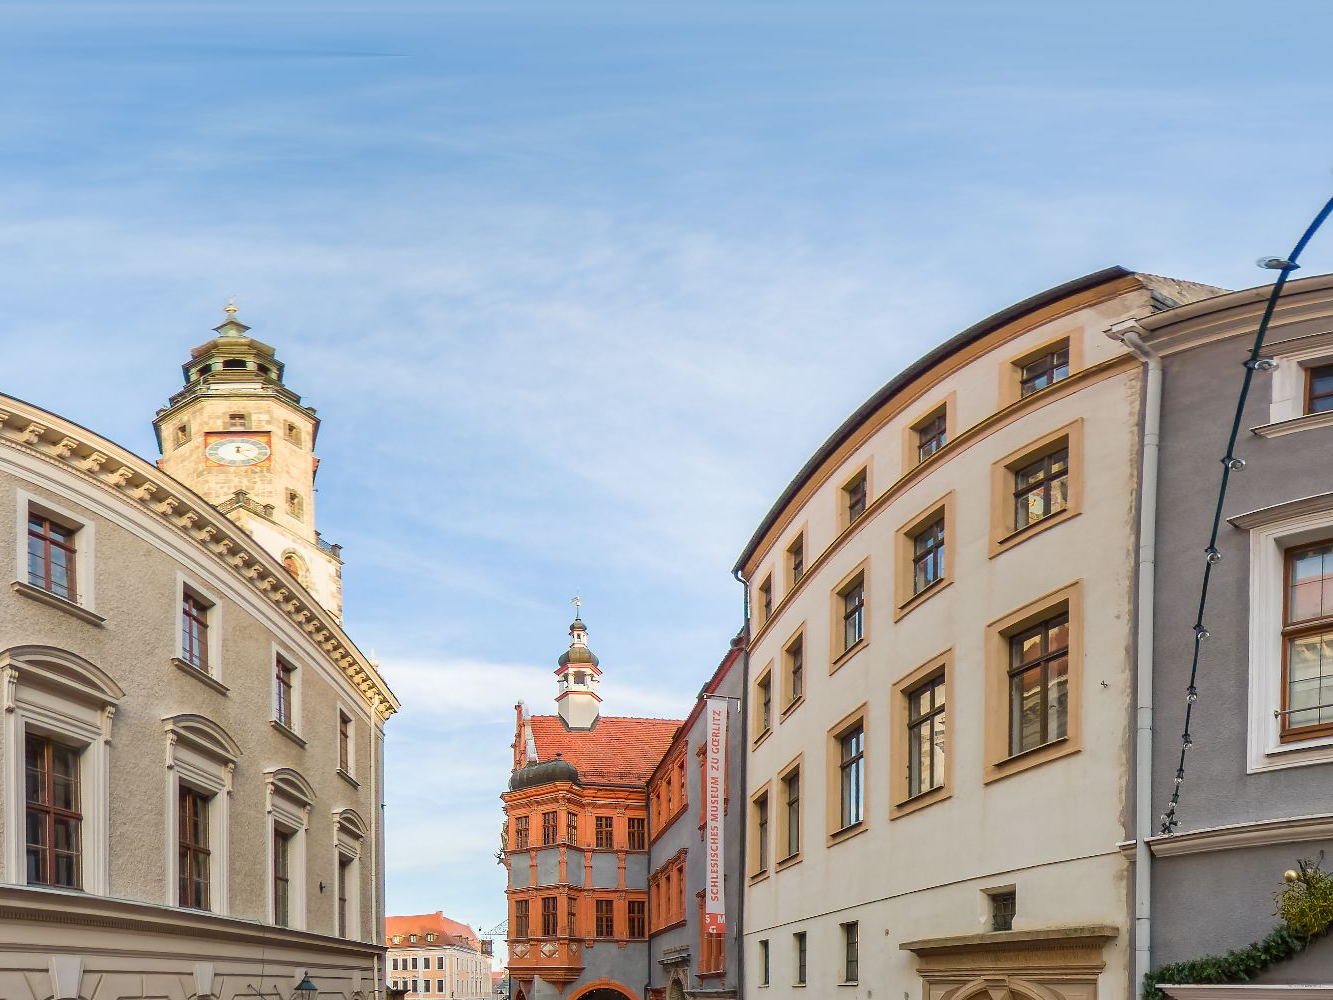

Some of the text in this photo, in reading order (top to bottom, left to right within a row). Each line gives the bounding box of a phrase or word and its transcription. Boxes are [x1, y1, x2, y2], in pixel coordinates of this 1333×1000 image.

[711, 757, 721, 773] ZU
[711, 776, 721, 821] MUSEUM
[710, 825, 721, 902] SCHLESISCHES
